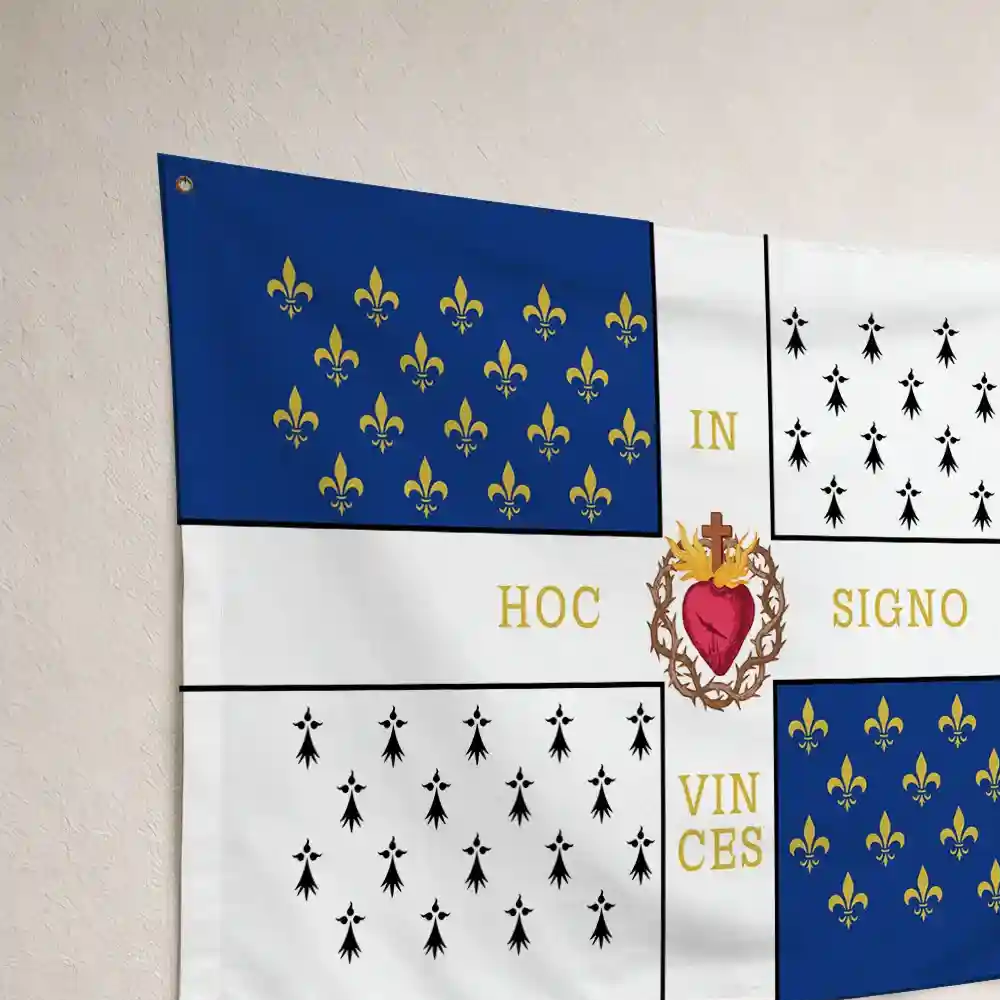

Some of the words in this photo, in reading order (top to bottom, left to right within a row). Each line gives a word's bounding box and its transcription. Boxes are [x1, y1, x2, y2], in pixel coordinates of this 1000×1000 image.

[690, 409, 738, 451] IN
[498, 585, 601, 628] HOC
[832, 588, 968, 628] SIGNO
[678, 772, 760, 816] VIN
[678, 826, 763, 871] CES
